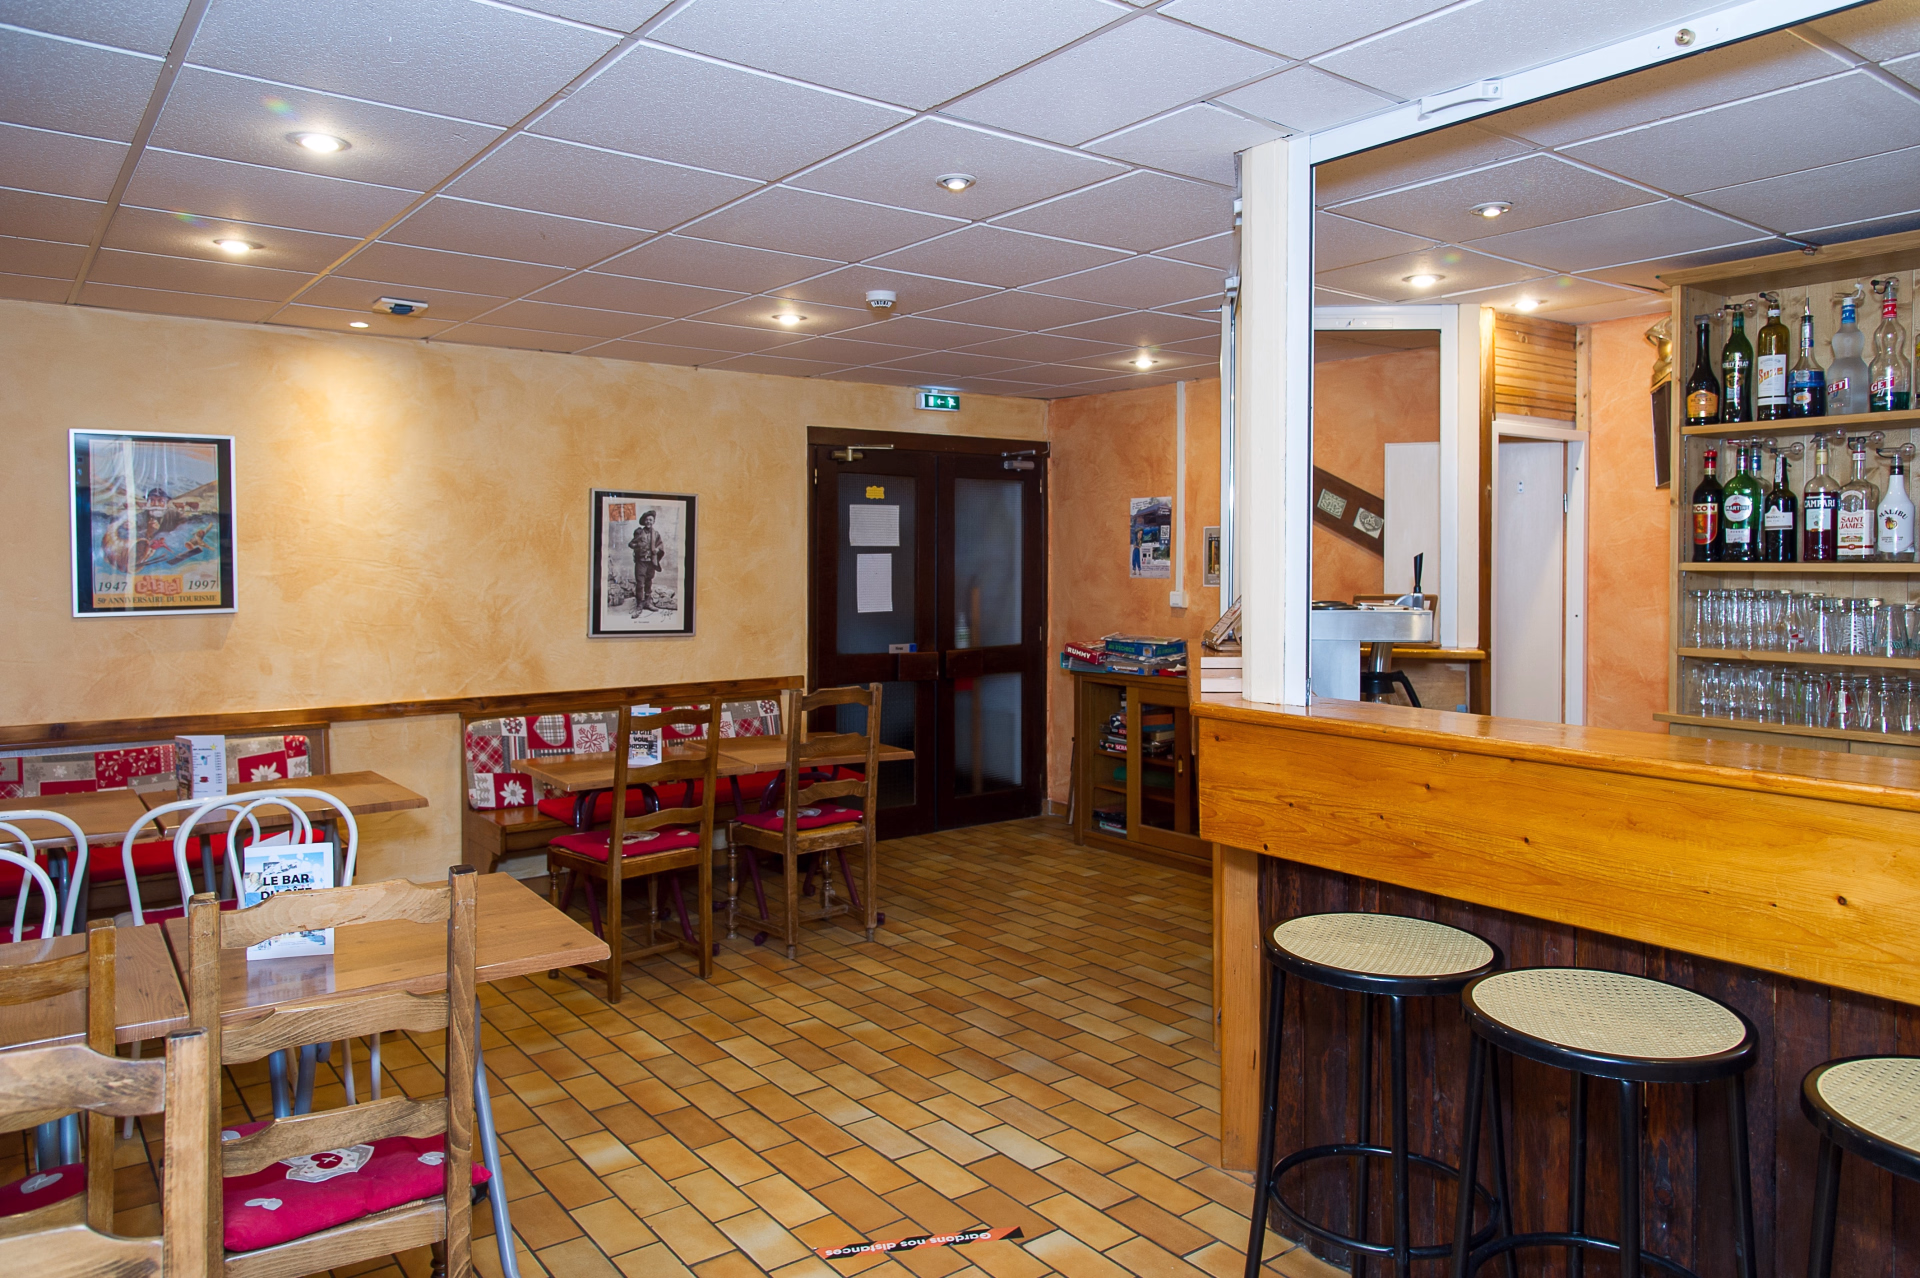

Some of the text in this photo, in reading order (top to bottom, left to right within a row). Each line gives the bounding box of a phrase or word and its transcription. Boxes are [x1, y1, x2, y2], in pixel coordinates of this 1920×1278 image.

[1725, 504, 1750, 512] MARTINI
[1804, 499, 1835, 508] CAMPARI
[1878, 509, 1908, 520] MALIBU
[1841, 516, 1863, 524] SAINT
[1839, 522, 1864, 530] JAMES
[98, 581, 128, 592] 1947
[188, 580, 216, 591] 1997
[108, 596, 163, 604] ANNIVERSAIRE
[179, 595, 217, 603] TOURISME
[1067, 646, 1091, 659] RUMMY
[263, 873, 310, 886] LE BAR
[825, 1232, 992, 1256] Gardons nos distances
